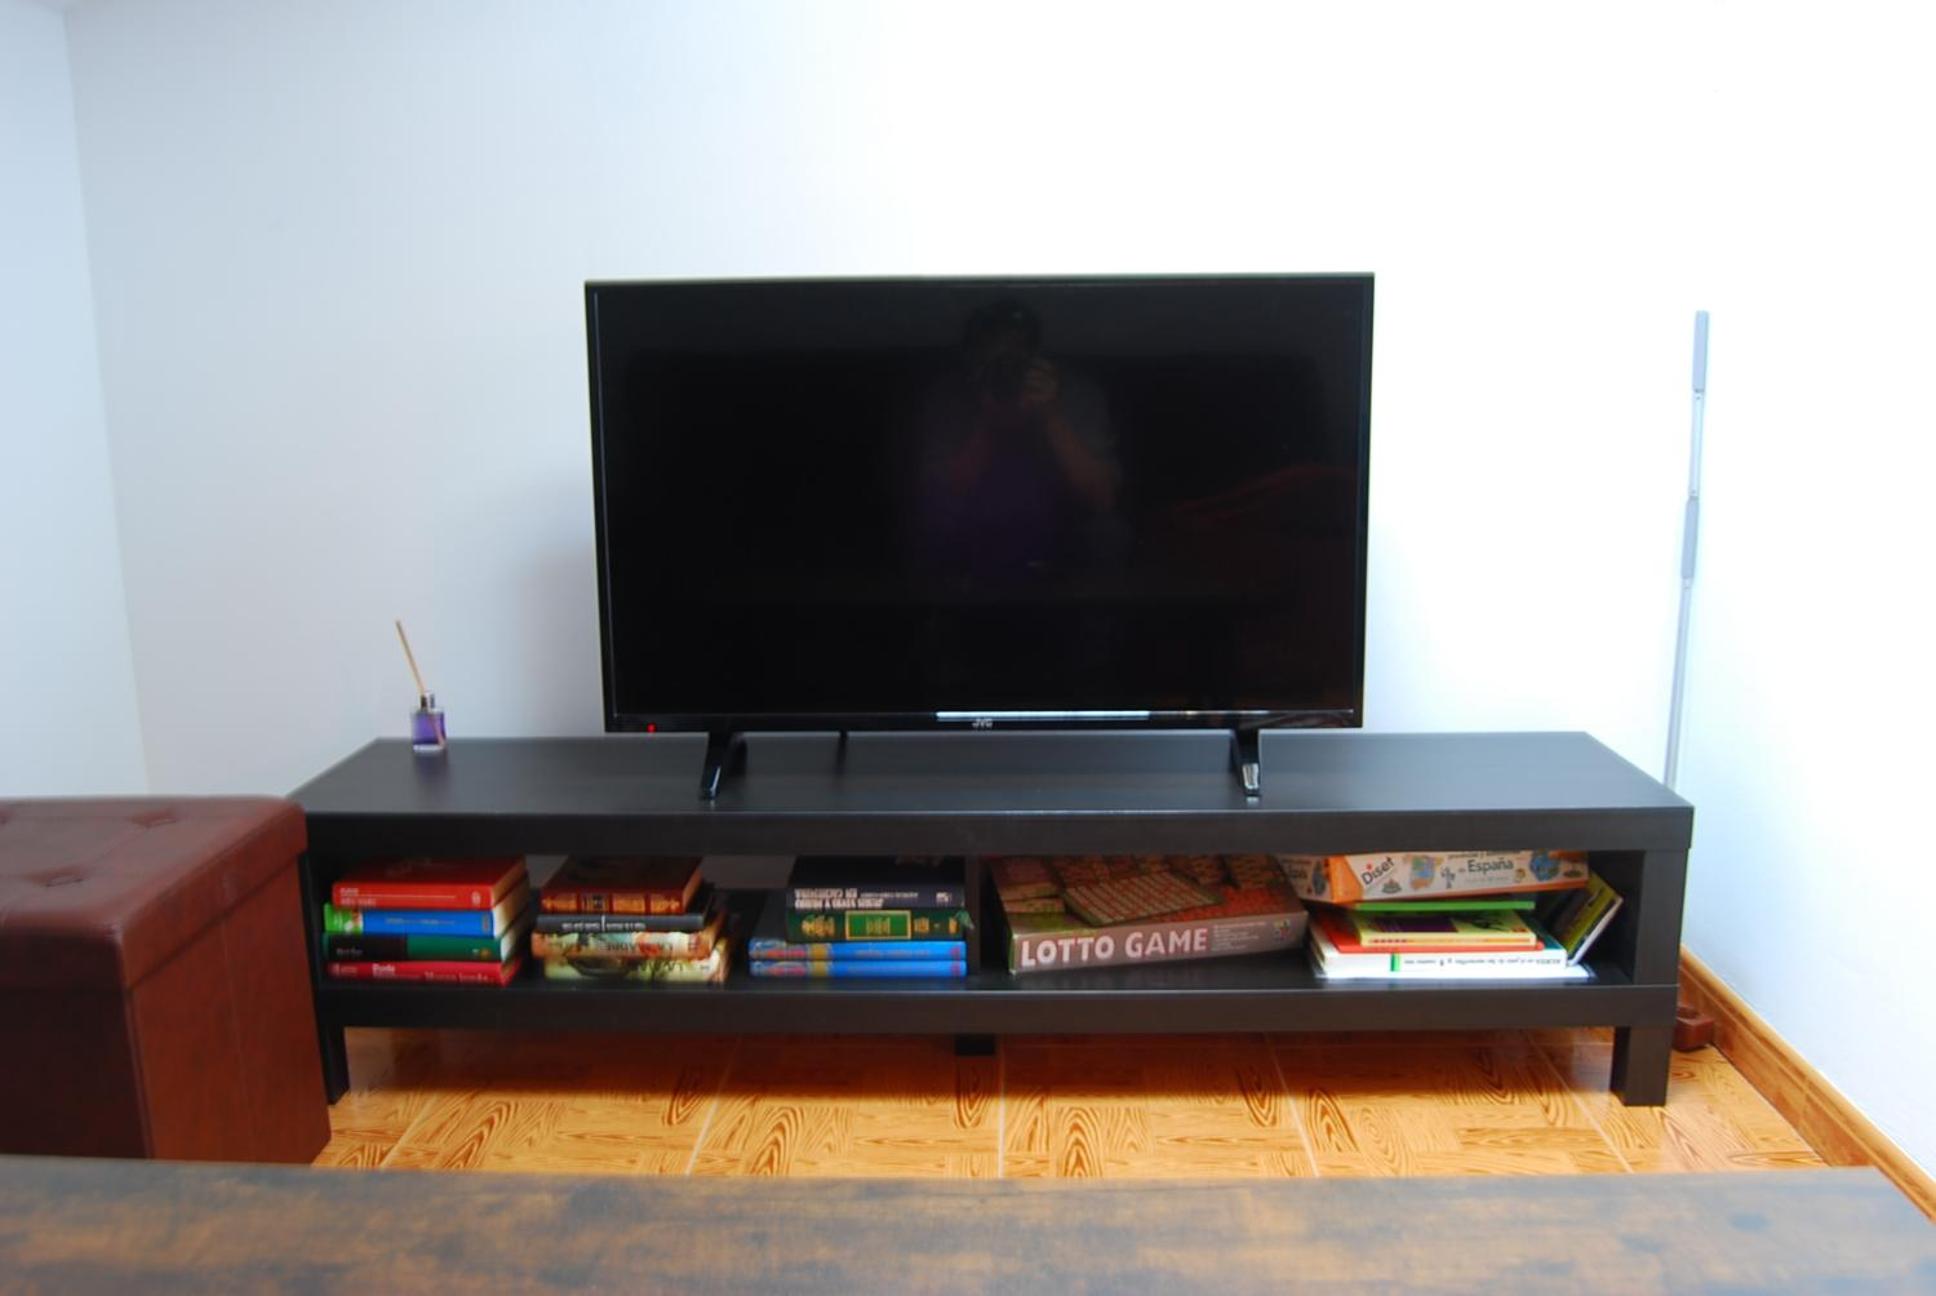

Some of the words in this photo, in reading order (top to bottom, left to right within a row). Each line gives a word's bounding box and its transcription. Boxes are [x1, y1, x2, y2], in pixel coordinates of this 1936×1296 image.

[972, 718, 993, 728] JVC
[1360, 856, 1395, 885] Diset
[1467, 857, 1514, 875] España
[1021, 936, 1114, 967] LOTTO
[1125, 928, 1208, 958] GAME
